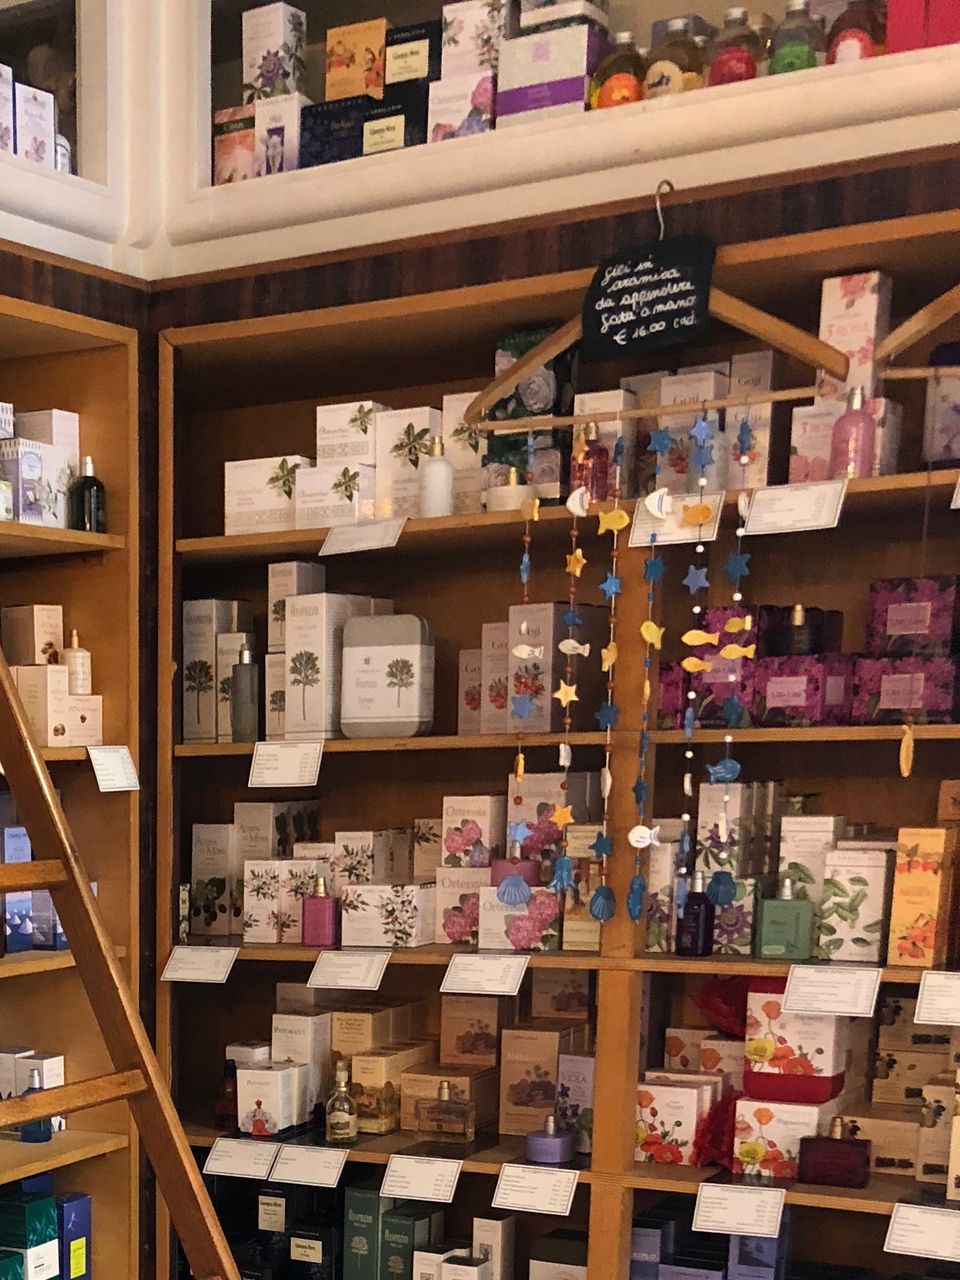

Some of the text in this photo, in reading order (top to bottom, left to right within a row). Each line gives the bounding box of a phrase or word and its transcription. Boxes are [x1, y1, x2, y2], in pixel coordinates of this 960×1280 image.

[653, 295, 697, 315] mano
[613, 329, 628, 345] €
[632, 321, 666, 339] 16.00
[445, 805, 487, 817] Ortensia
